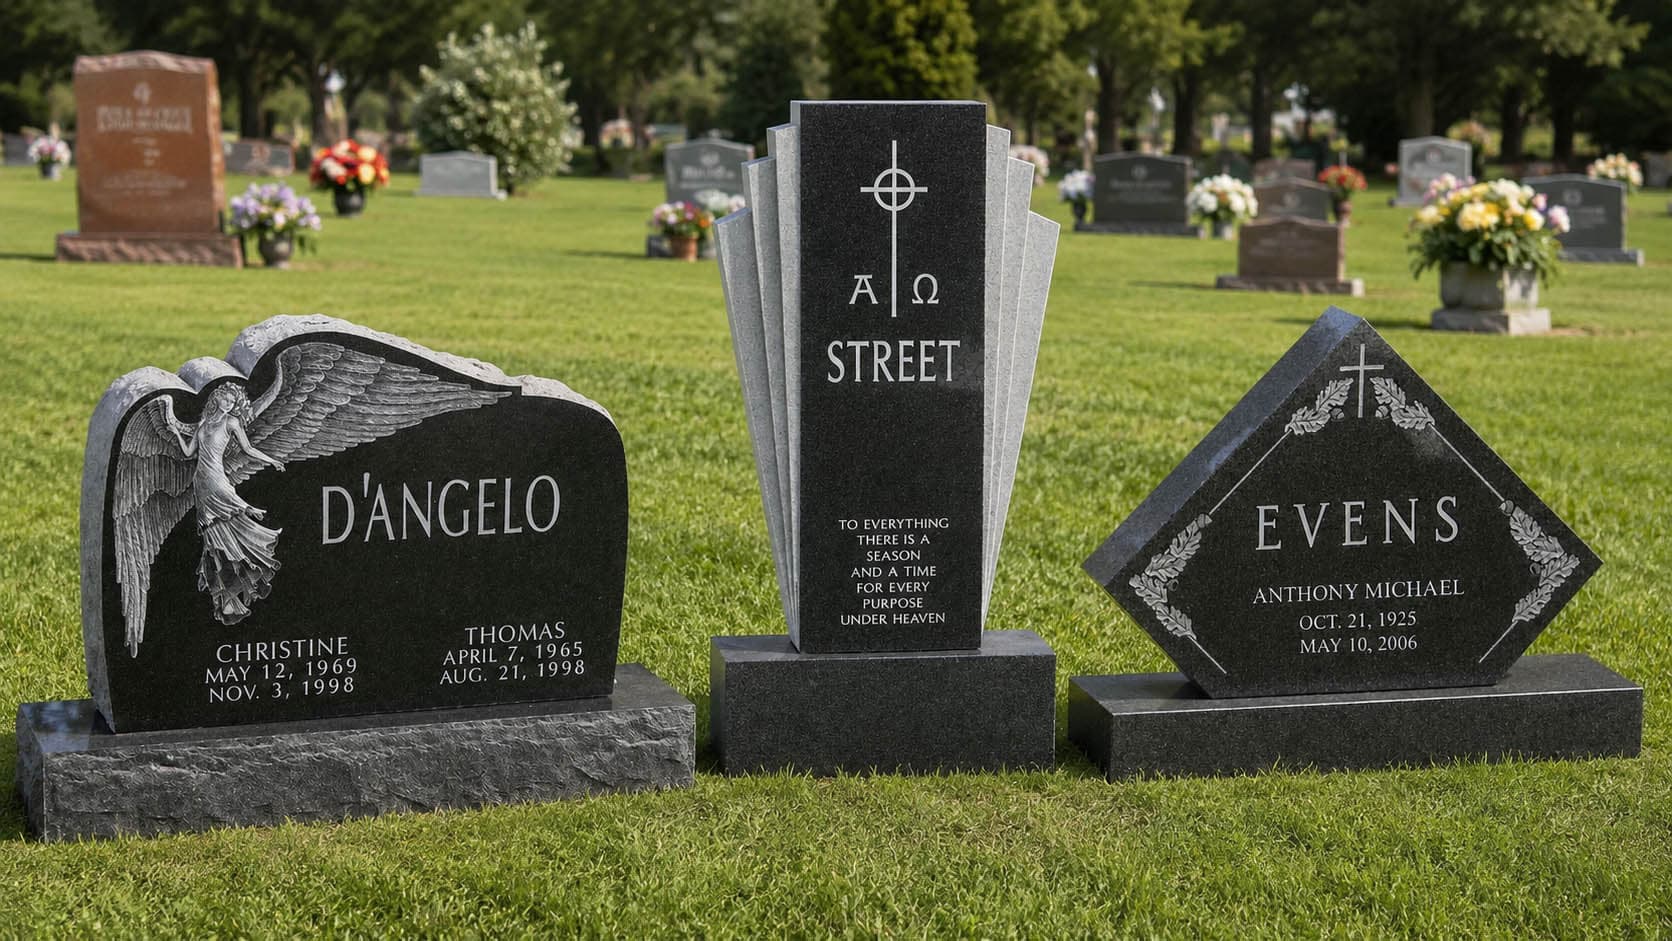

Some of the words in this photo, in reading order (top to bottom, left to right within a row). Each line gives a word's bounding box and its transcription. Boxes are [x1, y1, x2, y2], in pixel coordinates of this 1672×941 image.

[827, 340, 961, 384] STREET
[322, 472, 561, 545] D'ANGELO
[838, 518, 858, 531] TO
[864, 517, 949, 530] EVERYTHING
[1255, 495, 1459, 551] EVENS
[856, 534, 899, 546] THERE
[903, 533, 915, 545] IS
[920, 534, 930, 545] A
[866, 550, 921, 562] SEASON
[850, 566, 882, 578] AND
[887, 566, 899, 577] A
[903, 565, 937, 577] TIME
[856, 582, 884, 594] FOR
[889, 581, 930, 593] EVERY
[1252, 583, 1359, 604] ANTHONY
[1365, 579, 1465, 599] MICHAEL
[863, 597, 923, 609] PURPOSE
[840, 613, 888, 626] UNDER
[893, 612, 946, 625] HEAVEN
[1299, 614, 1342, 631] OCT.
[1348, 612, 1372, 630] 21,
[1379, 610, 1417, 627] 1925
[464, 621, 566, 646] THOMAS
[1300, 637, 1342, 654] MAY
[1350, 636, 1373, 654] 10,
[1378, 634, 1418, 651] 2006
[216, 636, 349, 663] CHRISTINE
[442, 647, 498, 666] APRIL
[507, 645, 525, 663] 7,
[535, 640, 583, 660] 1965
[205, 665, 251, 684] MAY
[262, 662, 293, 680] 12,
[306, 657, 357, 677] 1969
[439, 667, 487, 685] AUG.
[499, 664, 527, 681] 21,
[537, 659, 585, 678] 1998
[209, 684, 260, 703] NOV.
[271, 682, 290, 699] 3,
[302, 676, 354, 696] 1998
